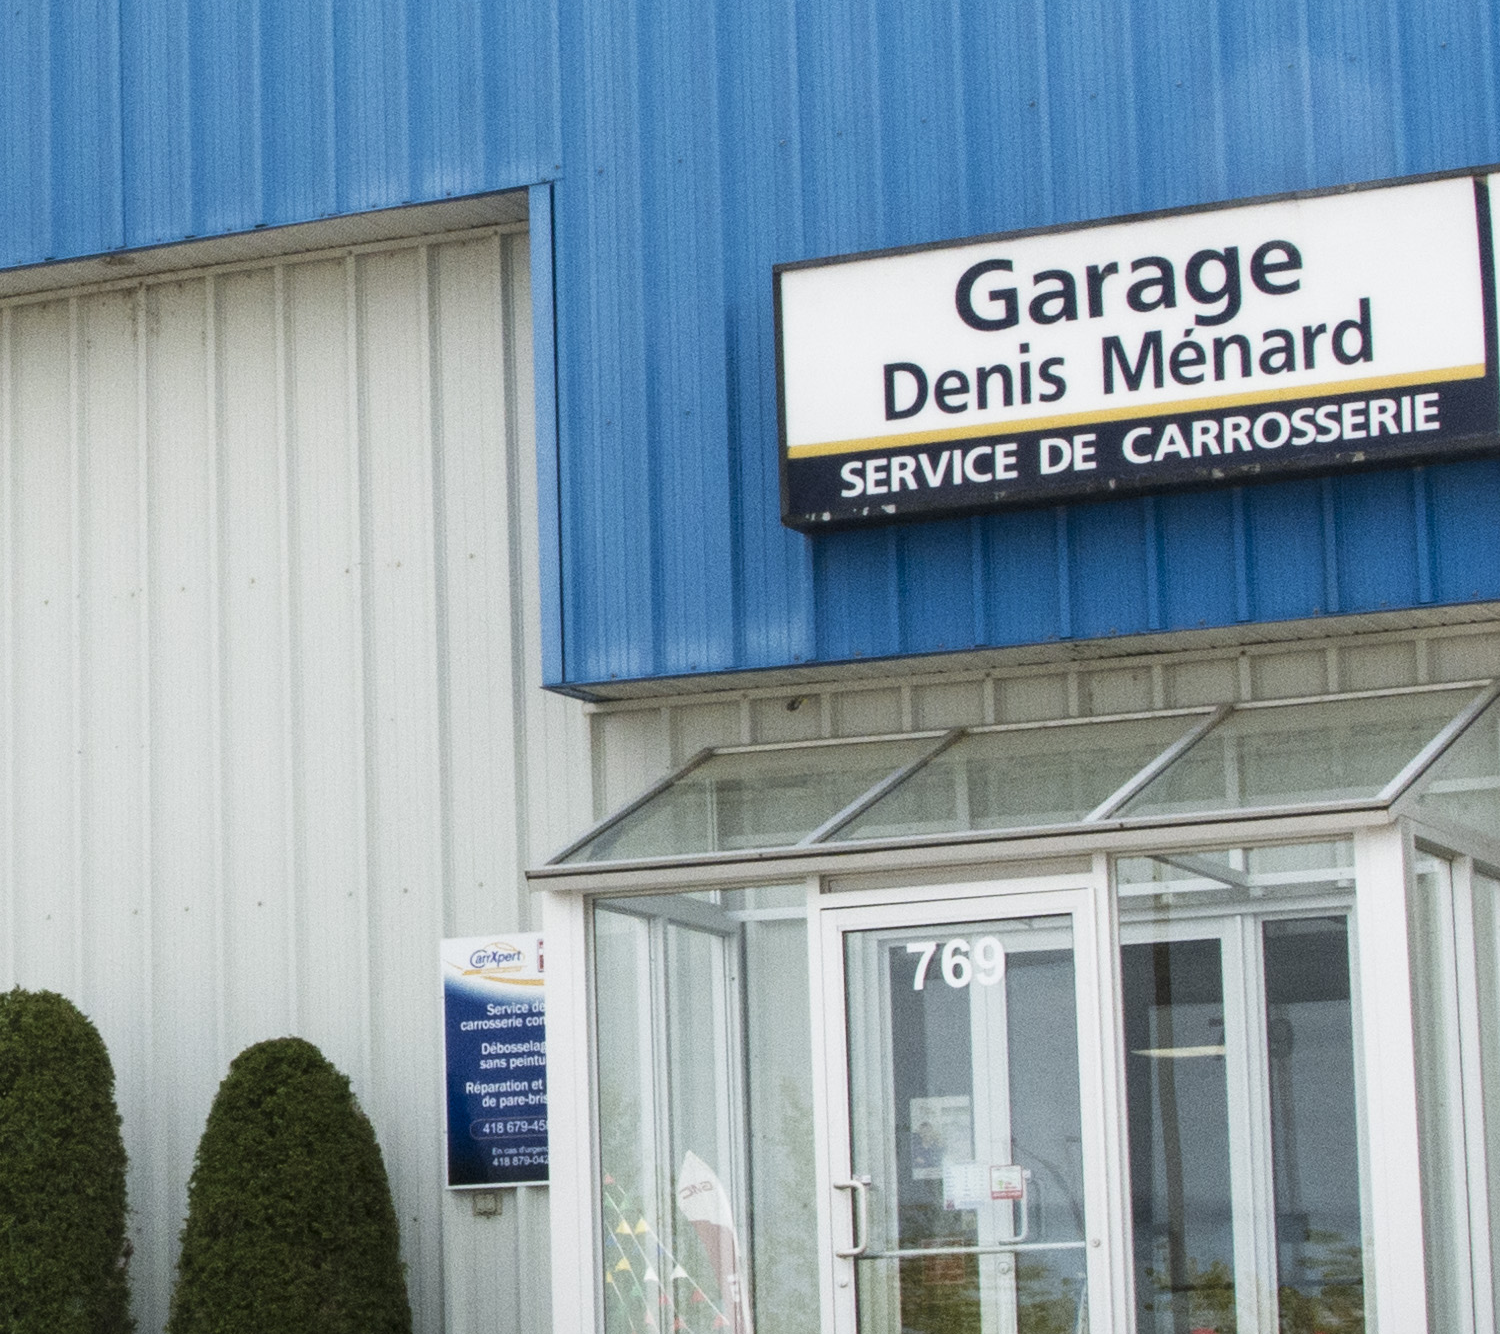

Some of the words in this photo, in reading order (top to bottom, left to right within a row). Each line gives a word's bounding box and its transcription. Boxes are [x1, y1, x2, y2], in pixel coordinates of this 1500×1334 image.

[954, 238, 1304, 333] Garage
[882, 342, 1067, 422] Denis
[1100, 297, 1375, 396] Ménard
[840, 442, 1019, 499] SERVICE
[1038, 432, 1098, 476] DE
[1121, 392, 1442, 466] CARROSSERIE
[906, 935, 1006, 991] 769
[486, 1001, 530, 1016] Service
[531, 1000, 546, 1013] de
[460, 1015, 523, 1031] carrosserie
[479, 1057, 508, 1069] sans
[465, 1078, 529, 1096] Réparation
[531, 1078, 544, 1090] et
[481, 1094, 497, 1108] de
[482, 1121, 504, 1134] 418
[491, 1147, 503, 1156] En
[503, 1147, 518, 1155] cas
[492, 1156, 511, 1167] 418
